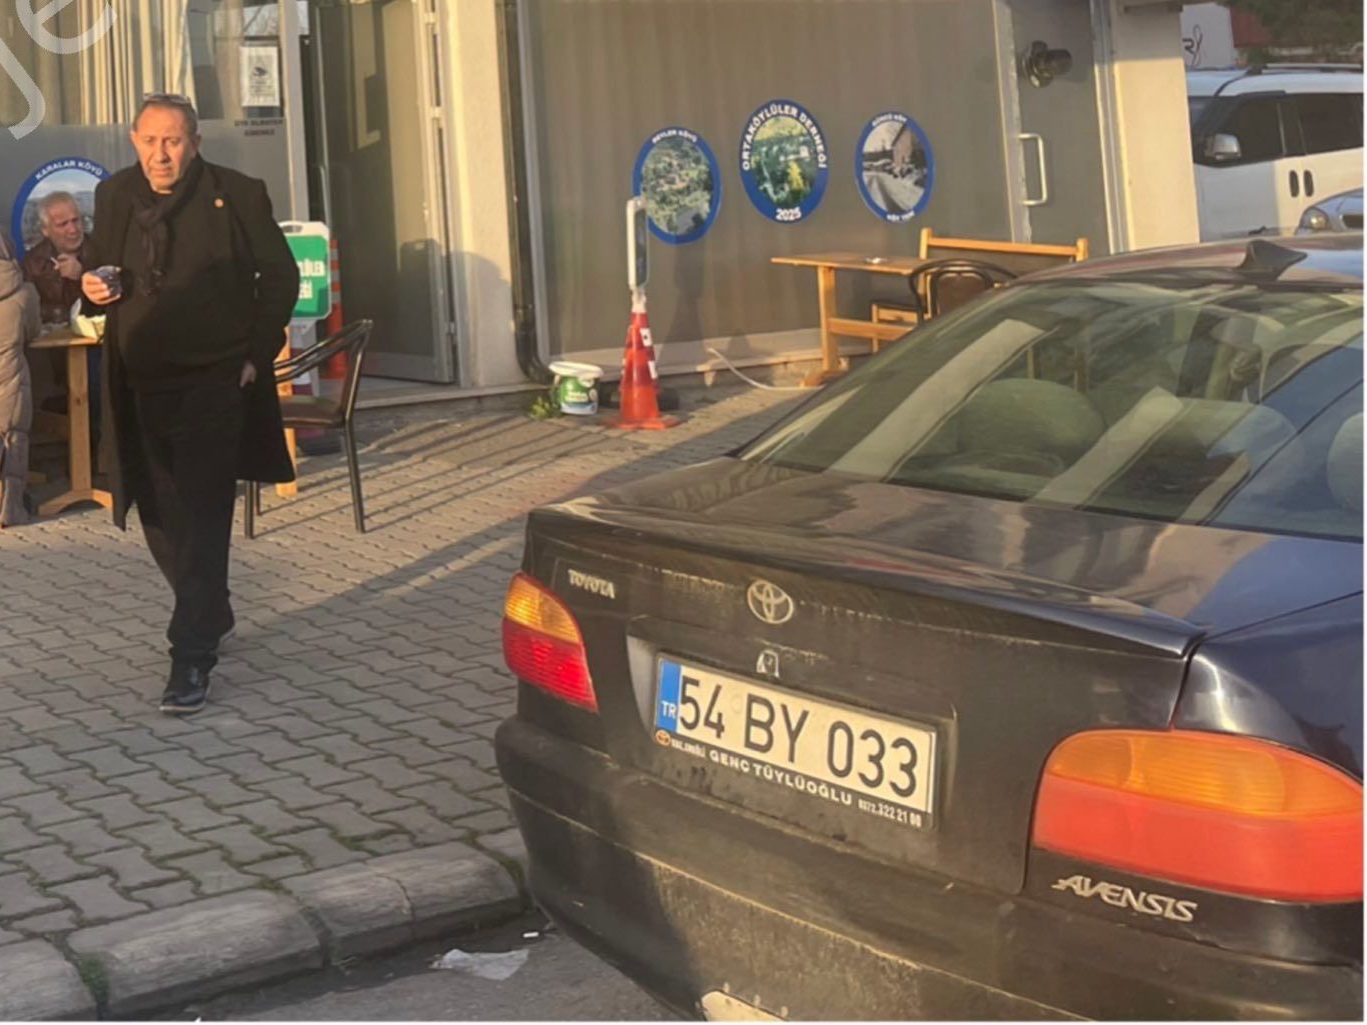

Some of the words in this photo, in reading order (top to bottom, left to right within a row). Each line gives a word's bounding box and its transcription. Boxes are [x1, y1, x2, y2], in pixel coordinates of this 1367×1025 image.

[35, 159, 77, 181] KARALAR
[77, 160, 103, 176] KÖYÜ
[775, 207, 802, 222] 2025
[567, 568, 615, 599] TOYOTA
[661, 699, 678, 719] TR
[680, 675, 726, 740] 54
[743, 692, 810, 764] BY
[826, 719, 919, 799] 033
[709, 748, 752, 773] GENÇ
[752, 762, 853, 806] TÜYLÜOĞLU
[1050, 875, 1198, 923] AVENSIS
